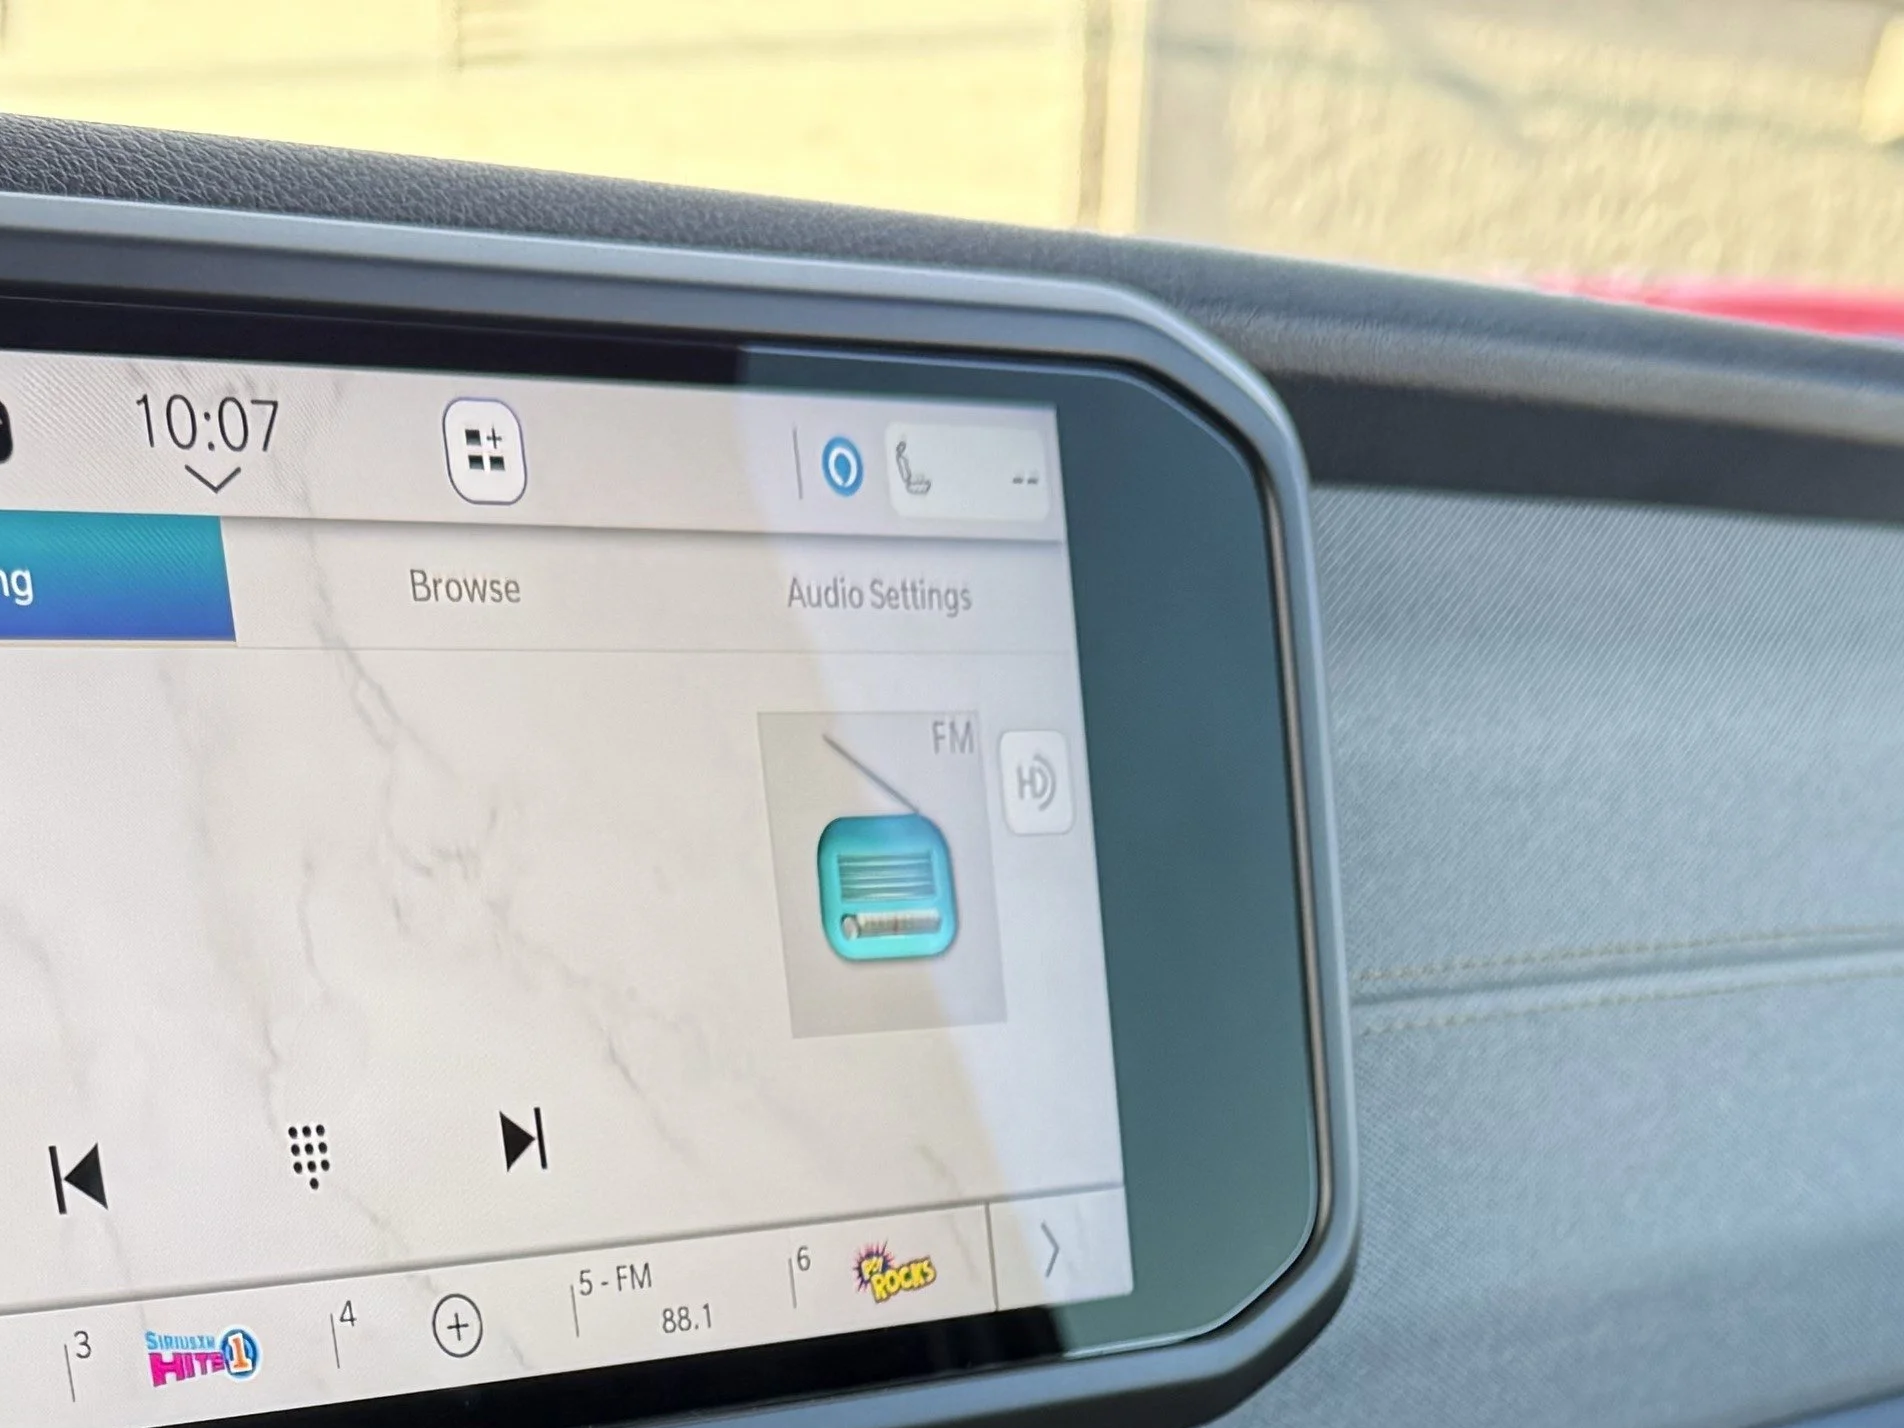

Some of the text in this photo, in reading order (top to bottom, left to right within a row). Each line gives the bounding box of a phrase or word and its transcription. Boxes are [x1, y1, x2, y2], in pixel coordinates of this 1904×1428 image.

[135, 393, 280, 453] 10:07
[408, 568, 522, 606] Browse
[786, 577, 973, 618] Audio Settings
[932, 720, 975, 755] FM
[795, 1247, 812, 1274] 6
[615, 1263, 654, 1292] FM
[339, 1301, 358, 1330] 4
[660, 1303, 714, 1335] 88.1
[74, 1331, 92, 1361] 3
